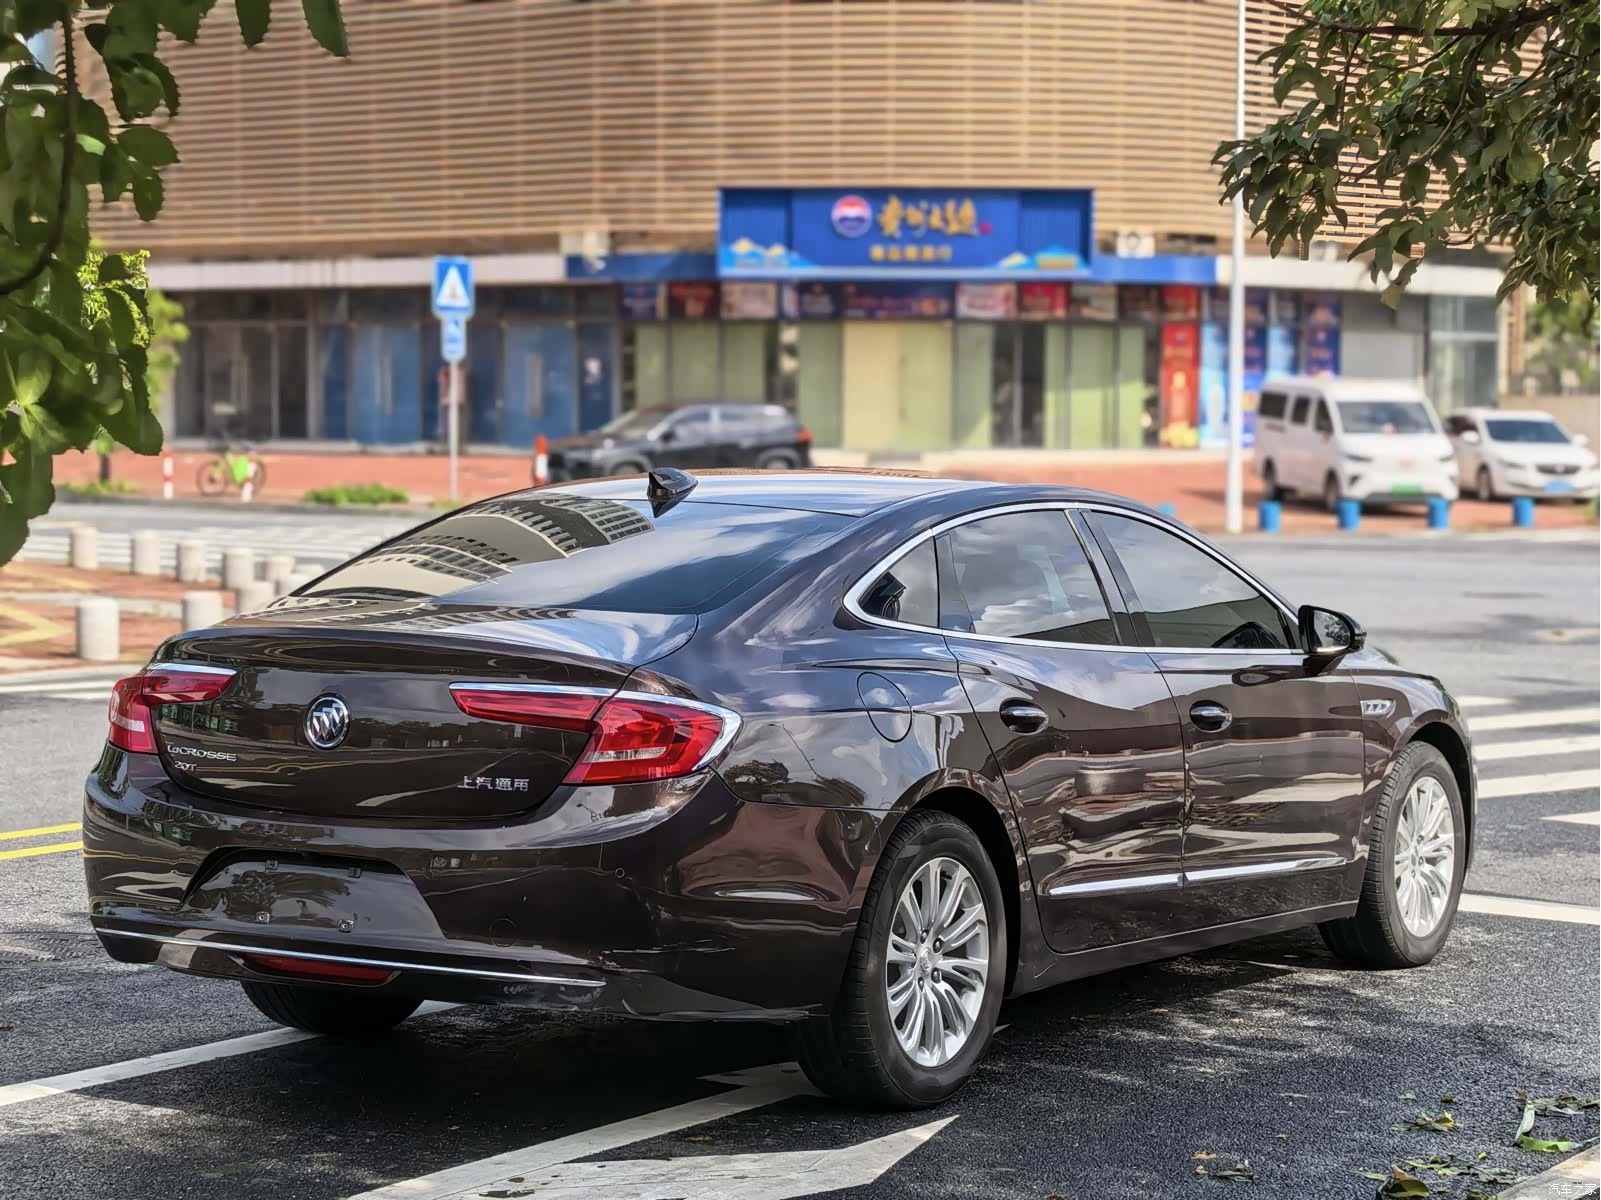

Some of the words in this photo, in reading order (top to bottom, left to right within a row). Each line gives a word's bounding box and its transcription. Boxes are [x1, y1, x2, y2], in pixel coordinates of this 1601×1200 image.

[174, 760, 197, 772] 20T
[457, 775, 530, 792] 上汽通用
